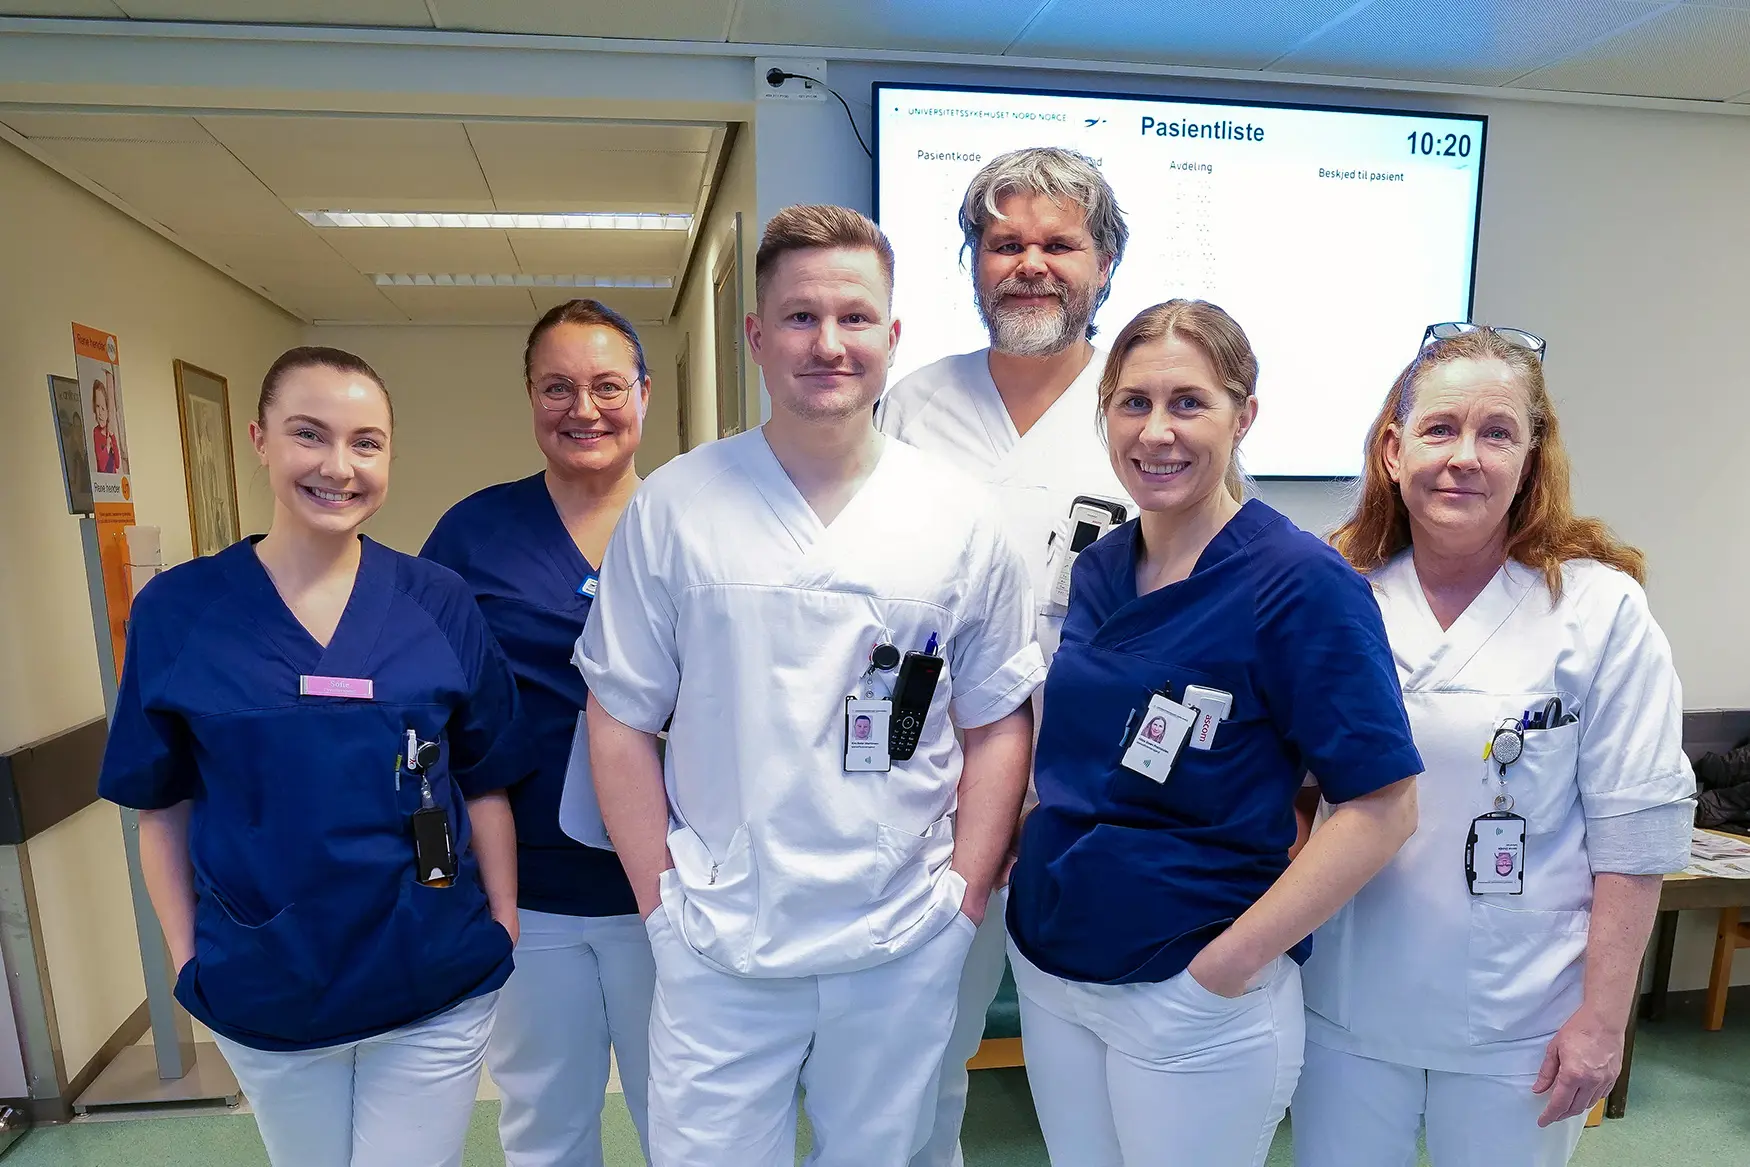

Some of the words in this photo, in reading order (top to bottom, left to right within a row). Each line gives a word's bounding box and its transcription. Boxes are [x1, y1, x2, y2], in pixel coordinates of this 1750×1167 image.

[1012, 112, 1036, 121] NORD
[1141, 116, 1265, 142] Pasientliste
[1407, 131, 1471, 157] 10:20
[917, 149, 981, 162] Pasientkode
[1169, 160, 1213, 174] Avdeling
[1318, 167, 1356, 181] Beskjed
[1358, 169, 1368, 180] til
[1369, 171, 1404, 182] pasient
[1199, 714, 1212, 742] ascom
